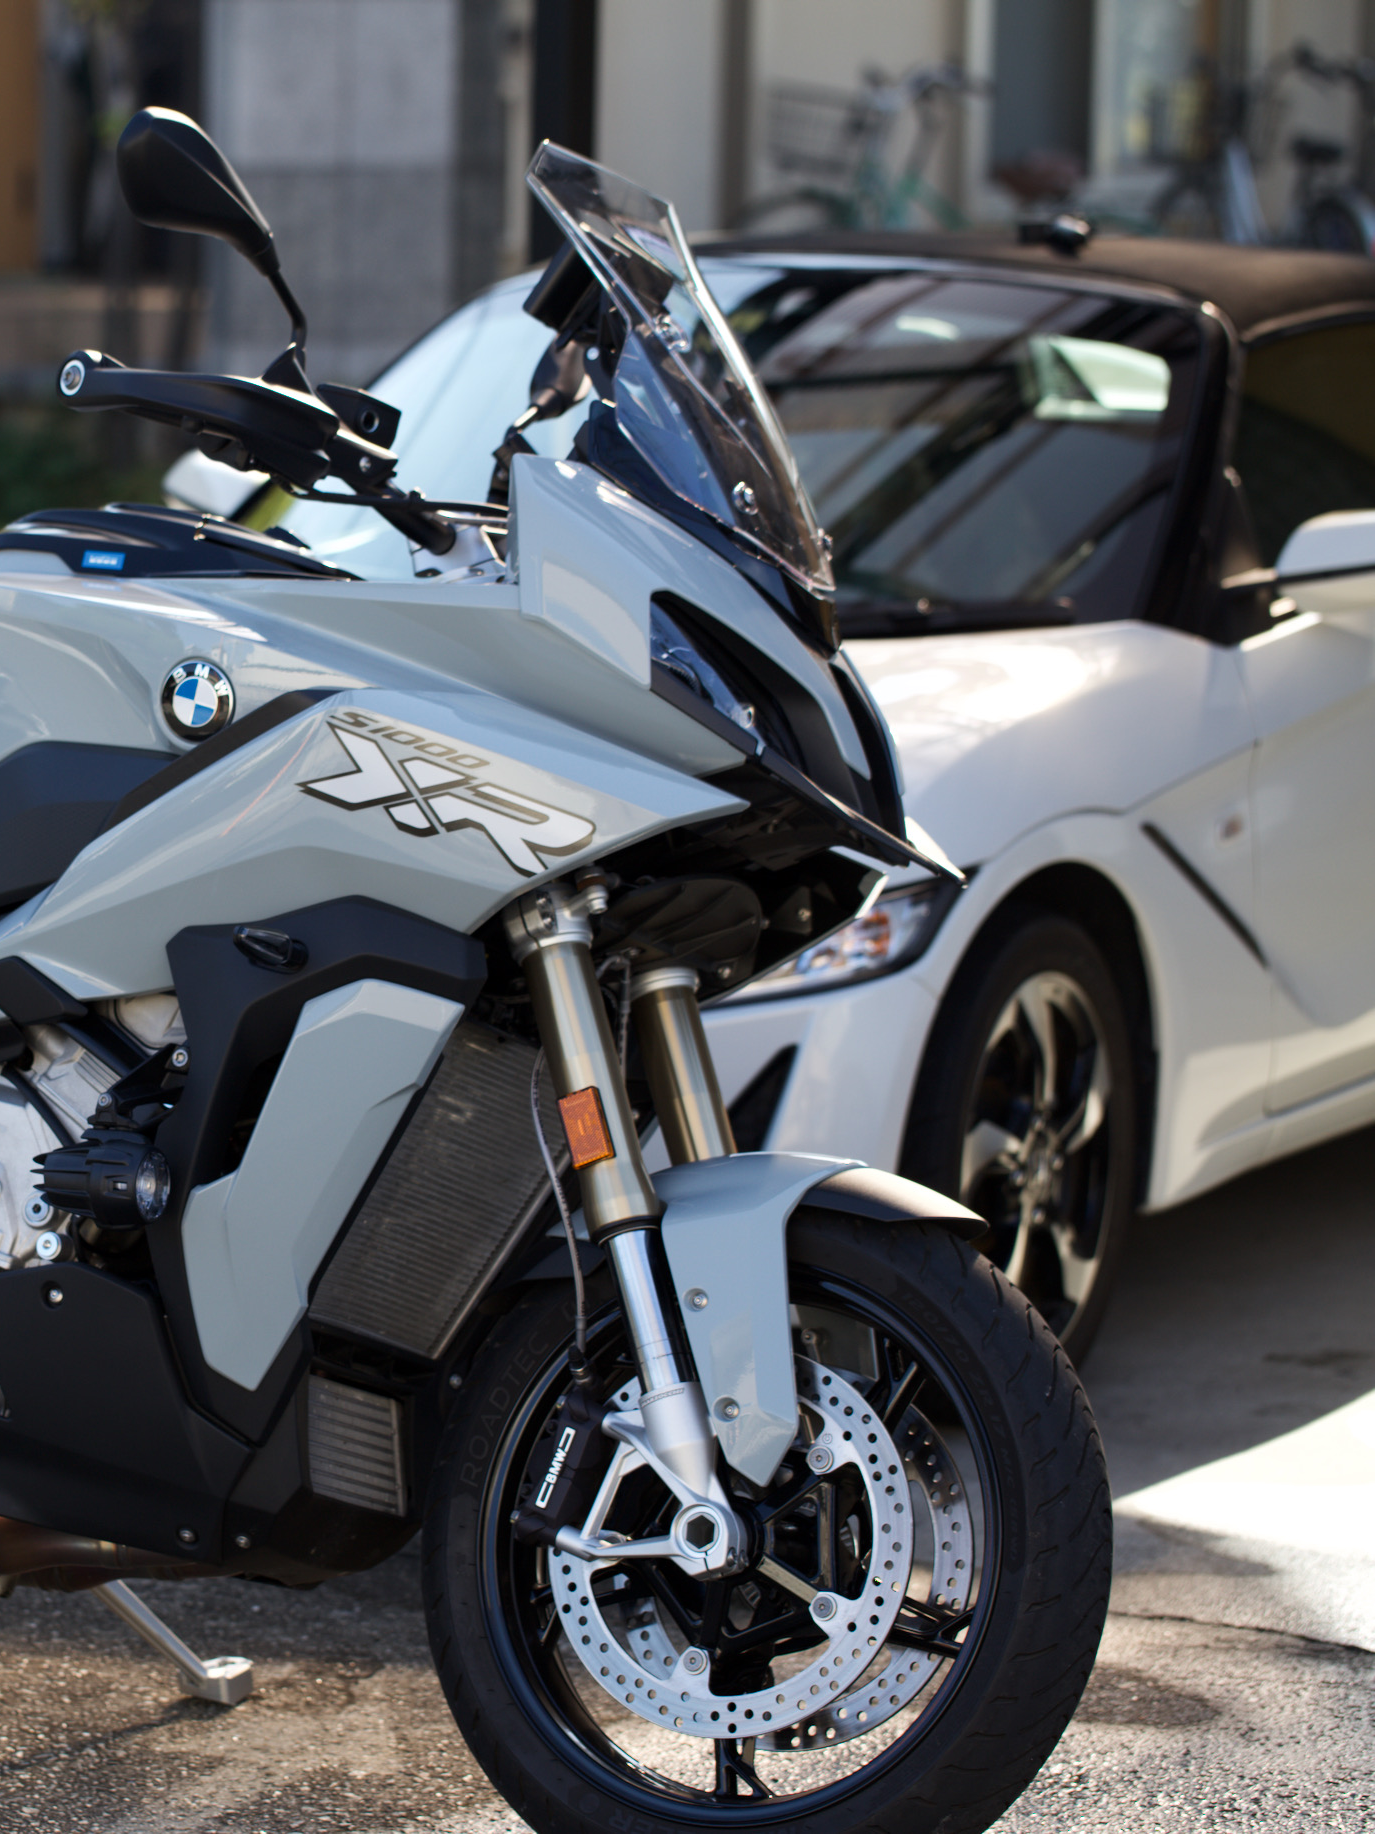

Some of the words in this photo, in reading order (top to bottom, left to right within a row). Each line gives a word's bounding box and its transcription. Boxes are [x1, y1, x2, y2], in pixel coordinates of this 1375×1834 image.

[172, 663, 230, 697] BMW
[328, 711, 491, 770] S1000
[294, 720, 597, 878] XR
[458, 1331, 550, 1488] ROADTEC
[544, 1448, 567, 1485] BMW
